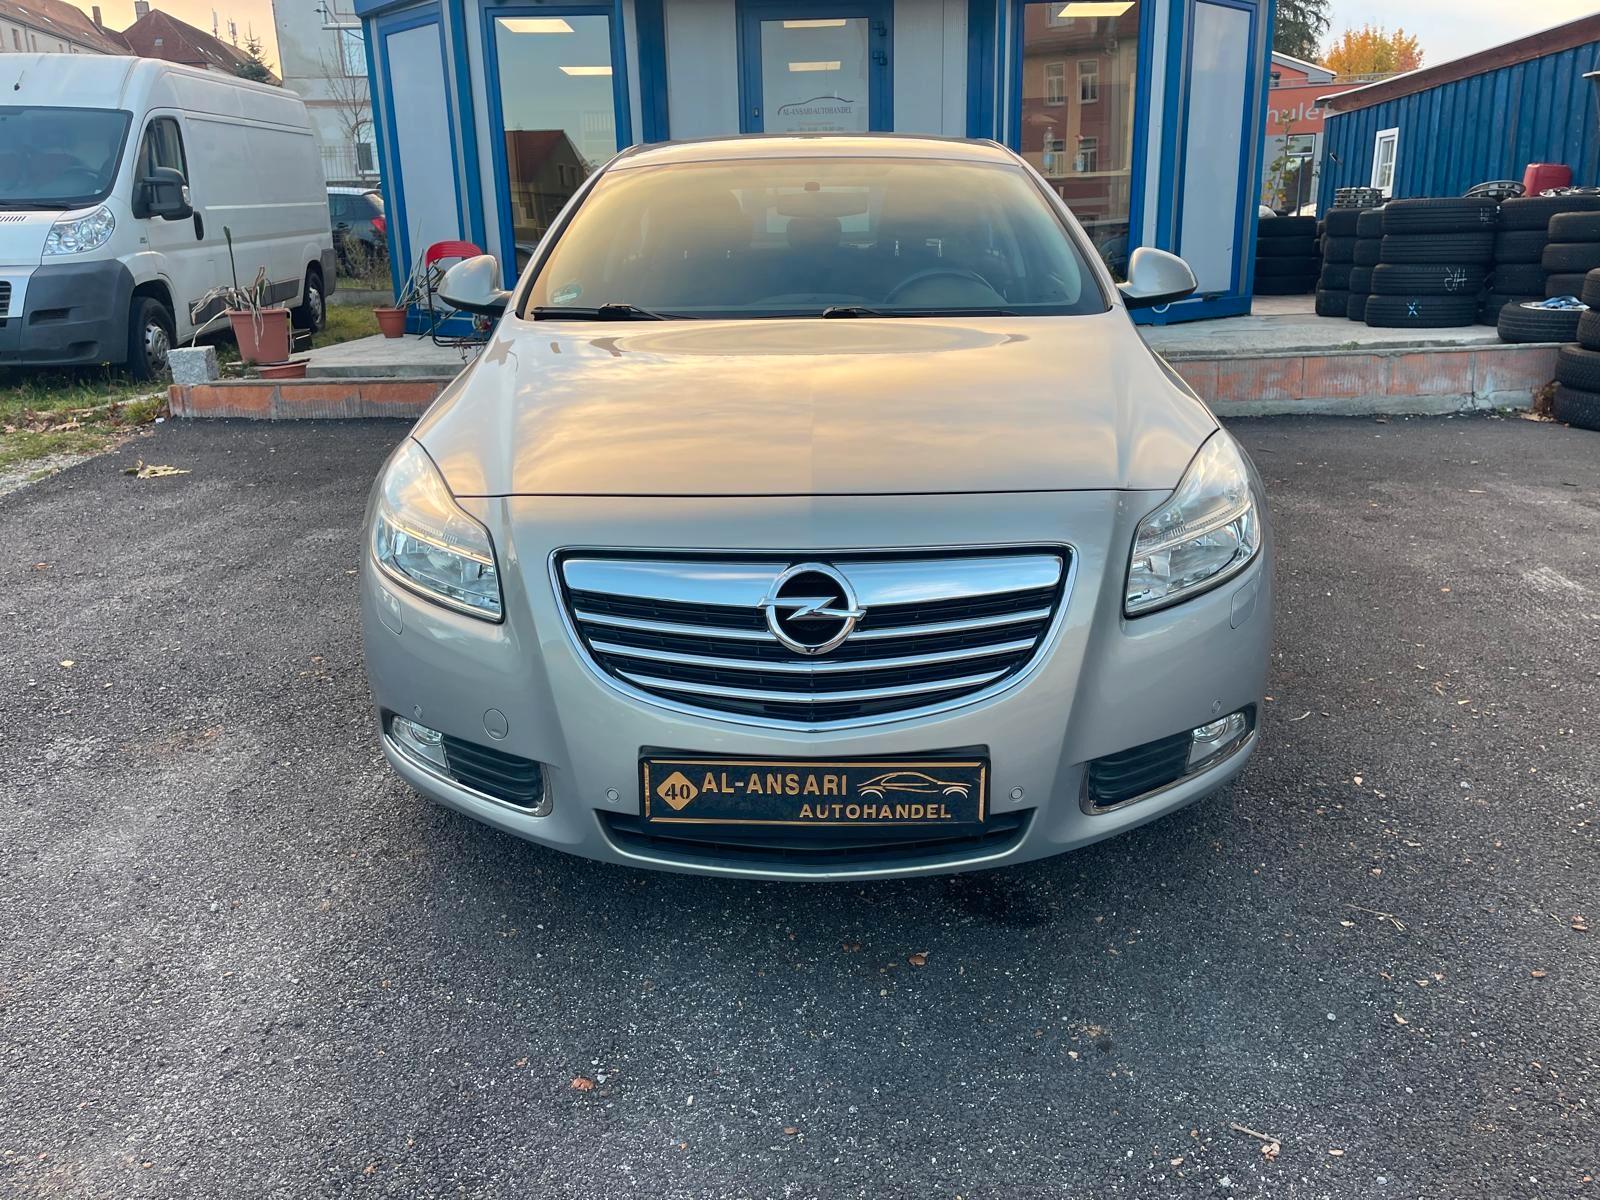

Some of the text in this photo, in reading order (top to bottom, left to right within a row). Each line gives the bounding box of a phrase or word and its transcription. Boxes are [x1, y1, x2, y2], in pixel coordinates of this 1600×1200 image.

[664, 772, 847, 800] 40 AL-ANSARI
[799, 803, 952, 820] AUTOHANDEL
